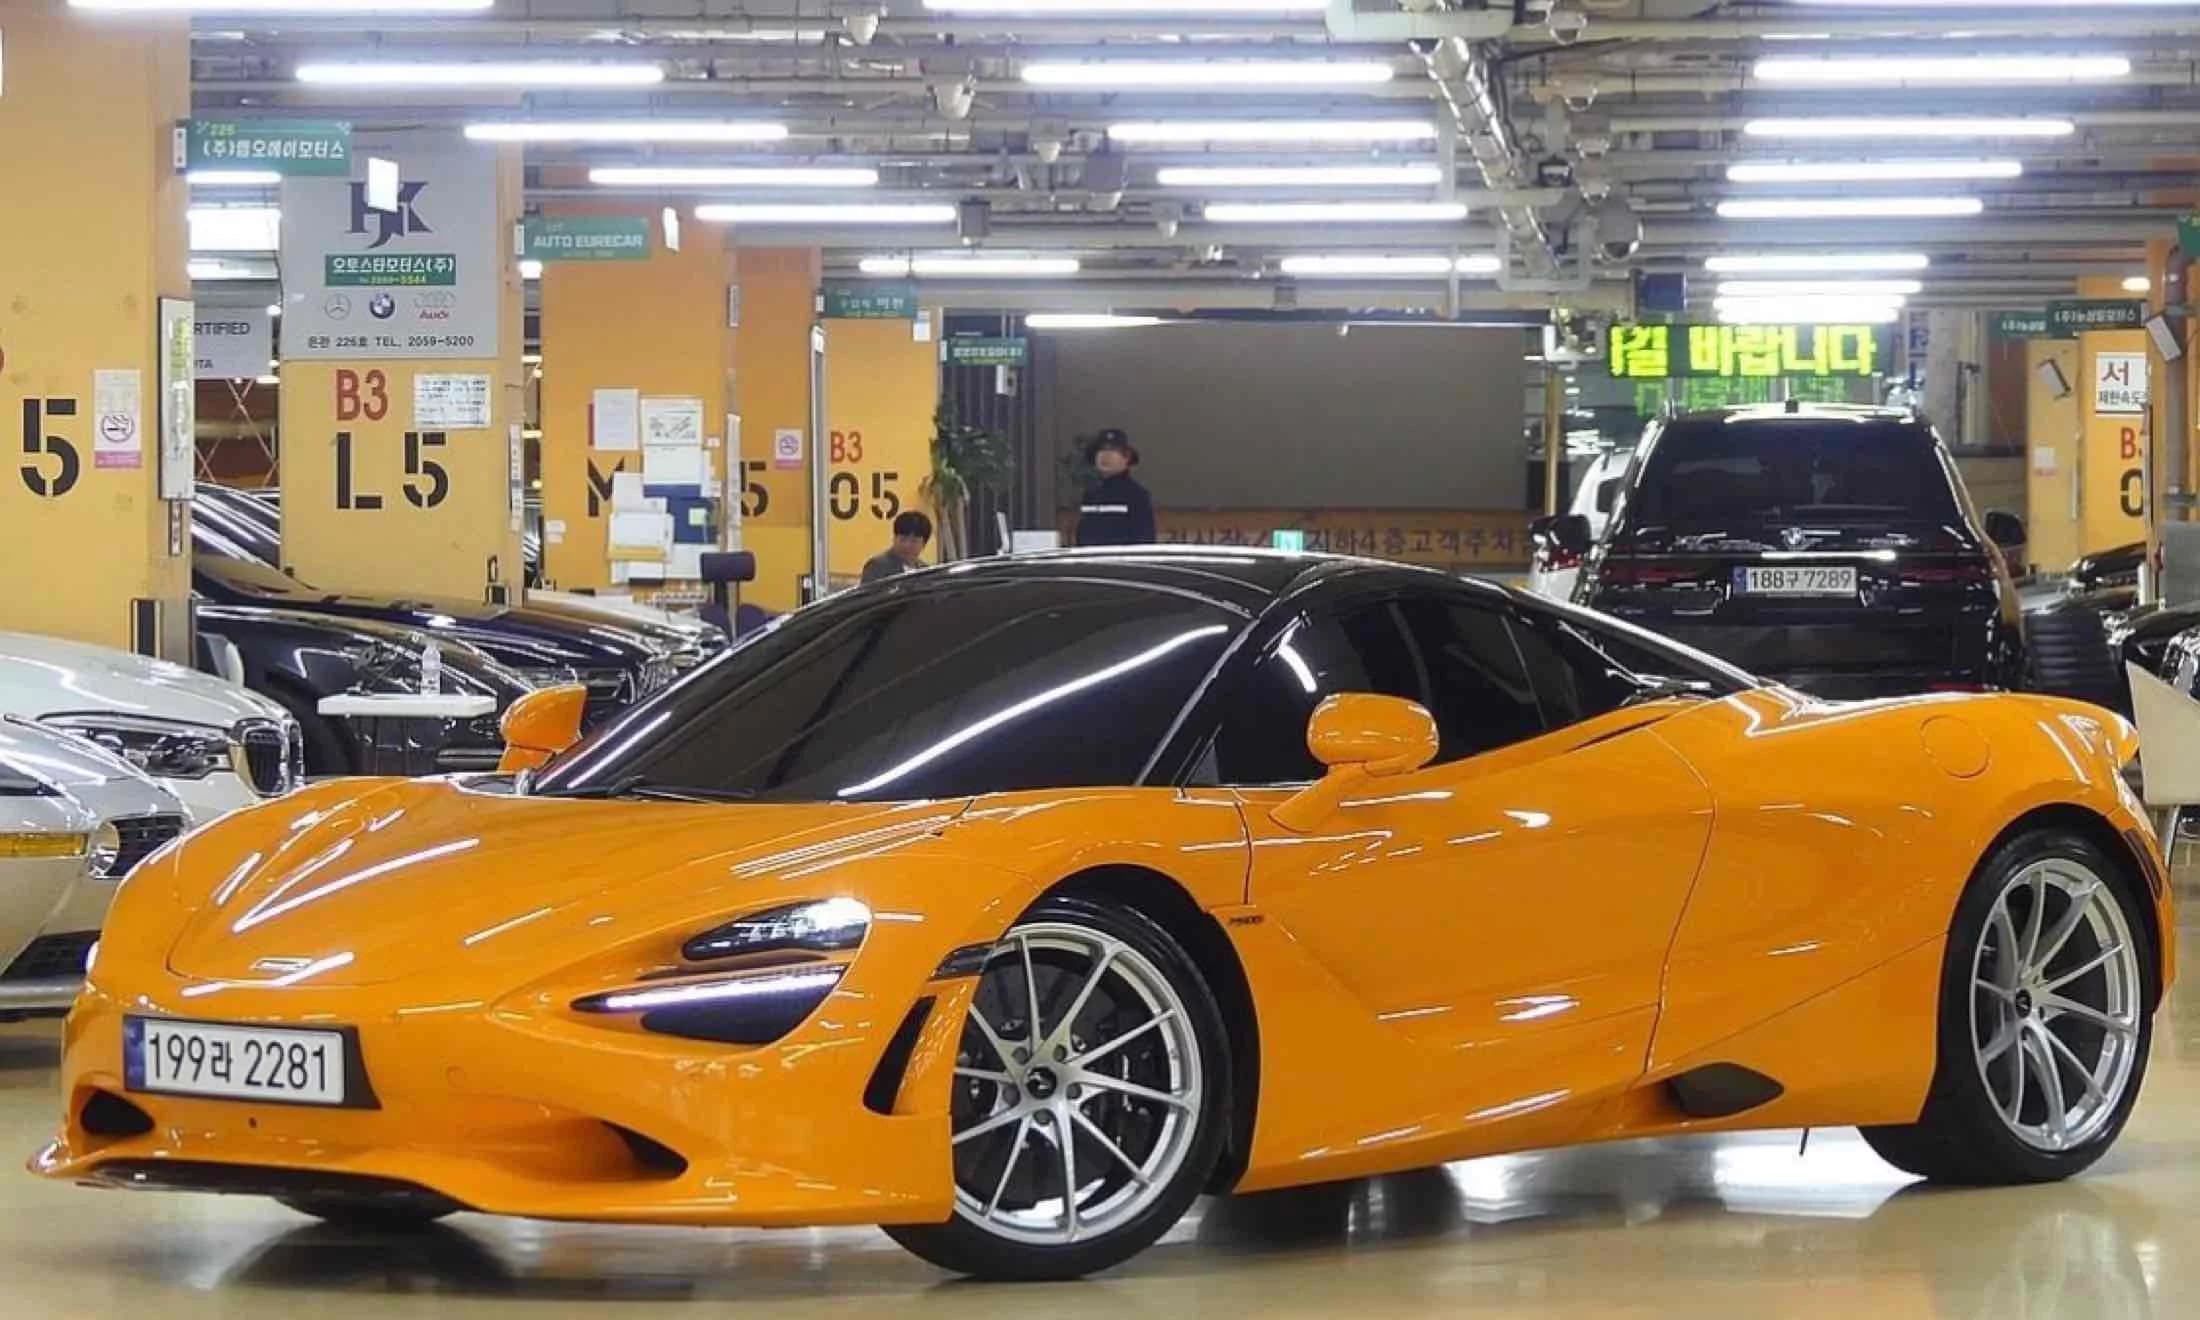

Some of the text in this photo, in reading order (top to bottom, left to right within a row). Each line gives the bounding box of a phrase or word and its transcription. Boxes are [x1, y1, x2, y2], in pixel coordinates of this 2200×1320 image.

[533, 235, 572, 248] AUTO
[420, 310, 449, 319] Audi
[408, 335, 475, 348] 2059-5200
[1688, 325, 1876, 375] 바랍니다
[2102, 361, 2129, 386] 서
[336, 368, 388, 421] B3
[21, 398, 79, 497] 5
[830, 431, 863, 463] B3
[2120, 427, 2143, 459] B
[740, 461, 769, 518] 5
[1807, 570, 1850, 589] 7289
[149, 1032, 326, 1092] 199라 2281
